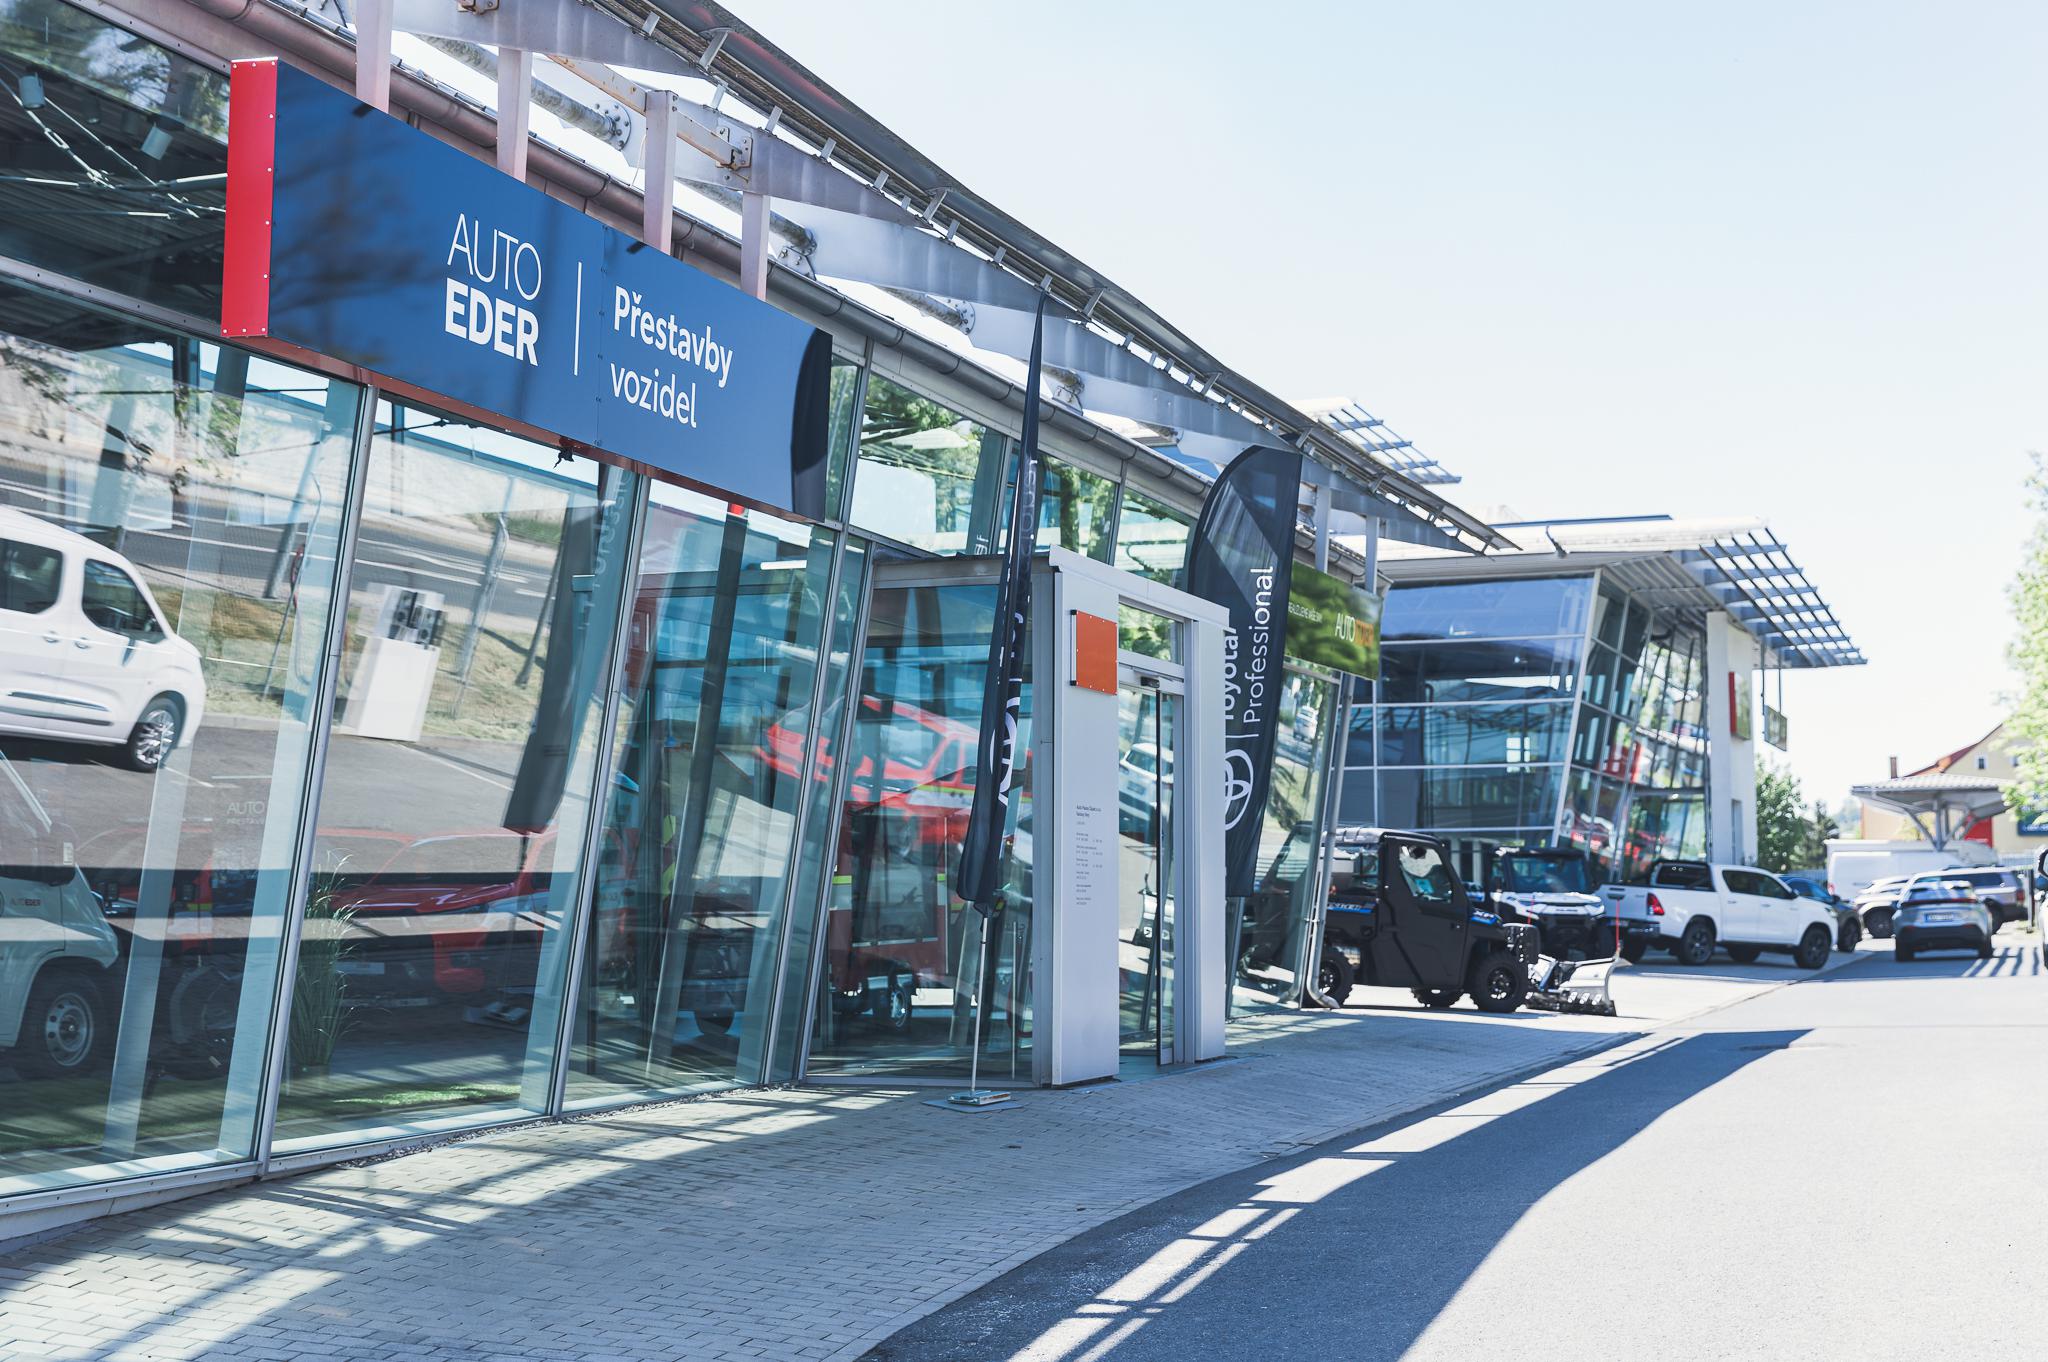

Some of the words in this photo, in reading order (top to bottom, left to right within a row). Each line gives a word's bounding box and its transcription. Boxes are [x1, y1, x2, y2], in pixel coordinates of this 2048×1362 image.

[447, 213, 542, 300] AUTO
[445, 277, 539, 367] EDER
[614, 285, 733, 388] Přestavby
[610, 363, 696, 428] vozidel
[1243, 566, 1274, 723] Professional
